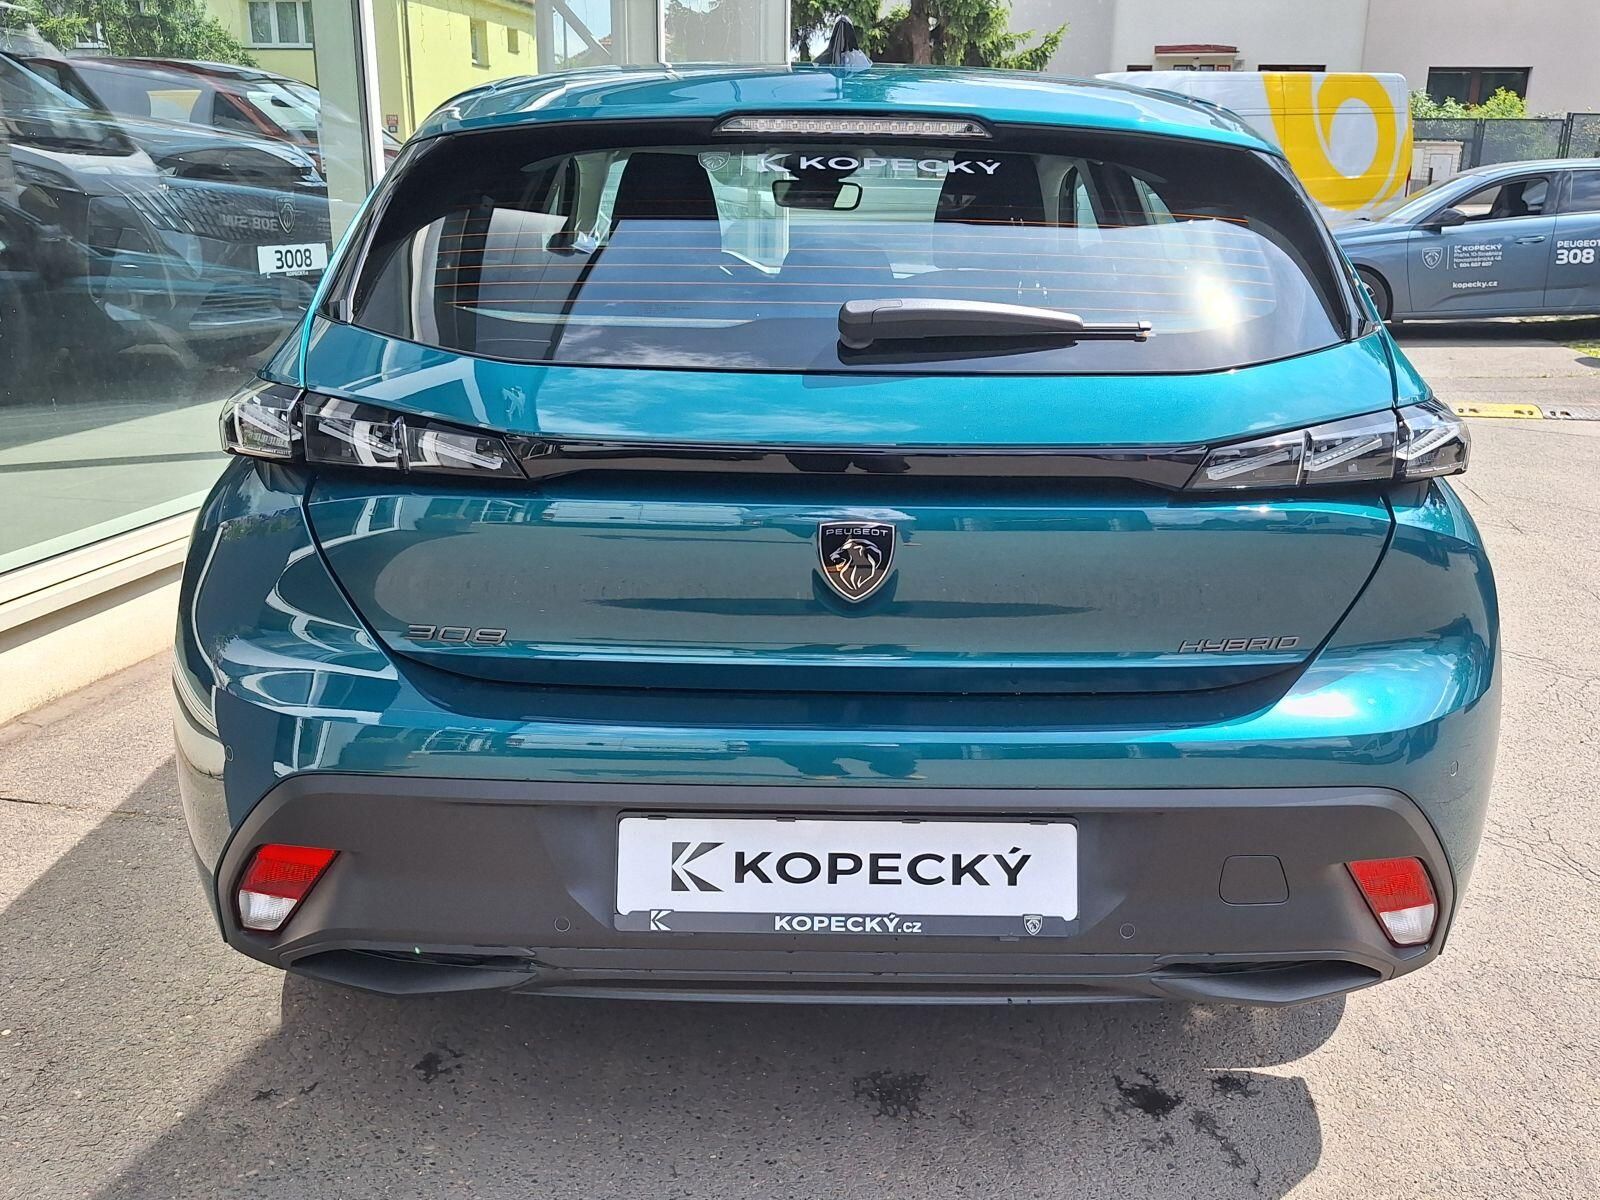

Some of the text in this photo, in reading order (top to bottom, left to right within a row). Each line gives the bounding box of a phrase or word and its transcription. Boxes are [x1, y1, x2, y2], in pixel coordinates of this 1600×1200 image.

[800, 156, 1001, 175] KOPECKÝ
[1557, 240, 1600, 248] PEUGEOT
[274, 248, 313, 269] 3008
[1555, 248, 1595, 265] 308
[1452, 281, 1498, 289] kopecky.cz
[825, 528, 889, 537] PEUGEOT
[404, 624, 508, 645] 308
[1178, 636, 1300, 653] HYBRID
[734, 846, 1032, 887] KOPECKÝ
[774, 912, 922, 934] KOPECKÝ.cz
